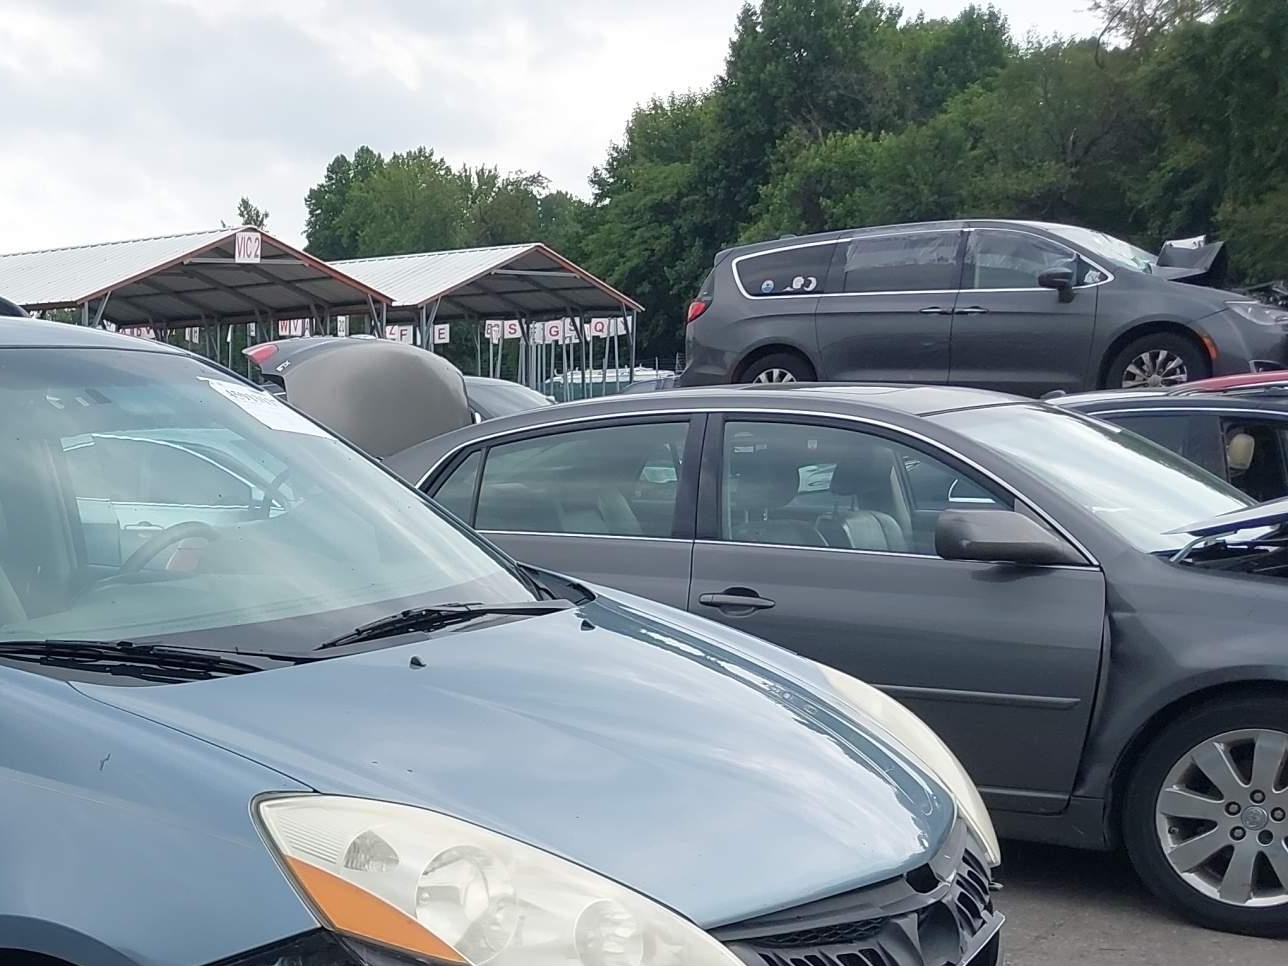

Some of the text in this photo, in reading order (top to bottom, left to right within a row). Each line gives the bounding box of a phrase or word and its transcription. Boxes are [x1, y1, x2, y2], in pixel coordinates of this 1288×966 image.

[237, 236, 260, 258] VIC 2
[281, 320, 288, 333] W
[508, 323, 517, 335] S
[549, 325, 559, 337] G
[594, 321, 605, 333] Q
[400, 329, 408, 341] F
[438, 328, 446, 340] E
